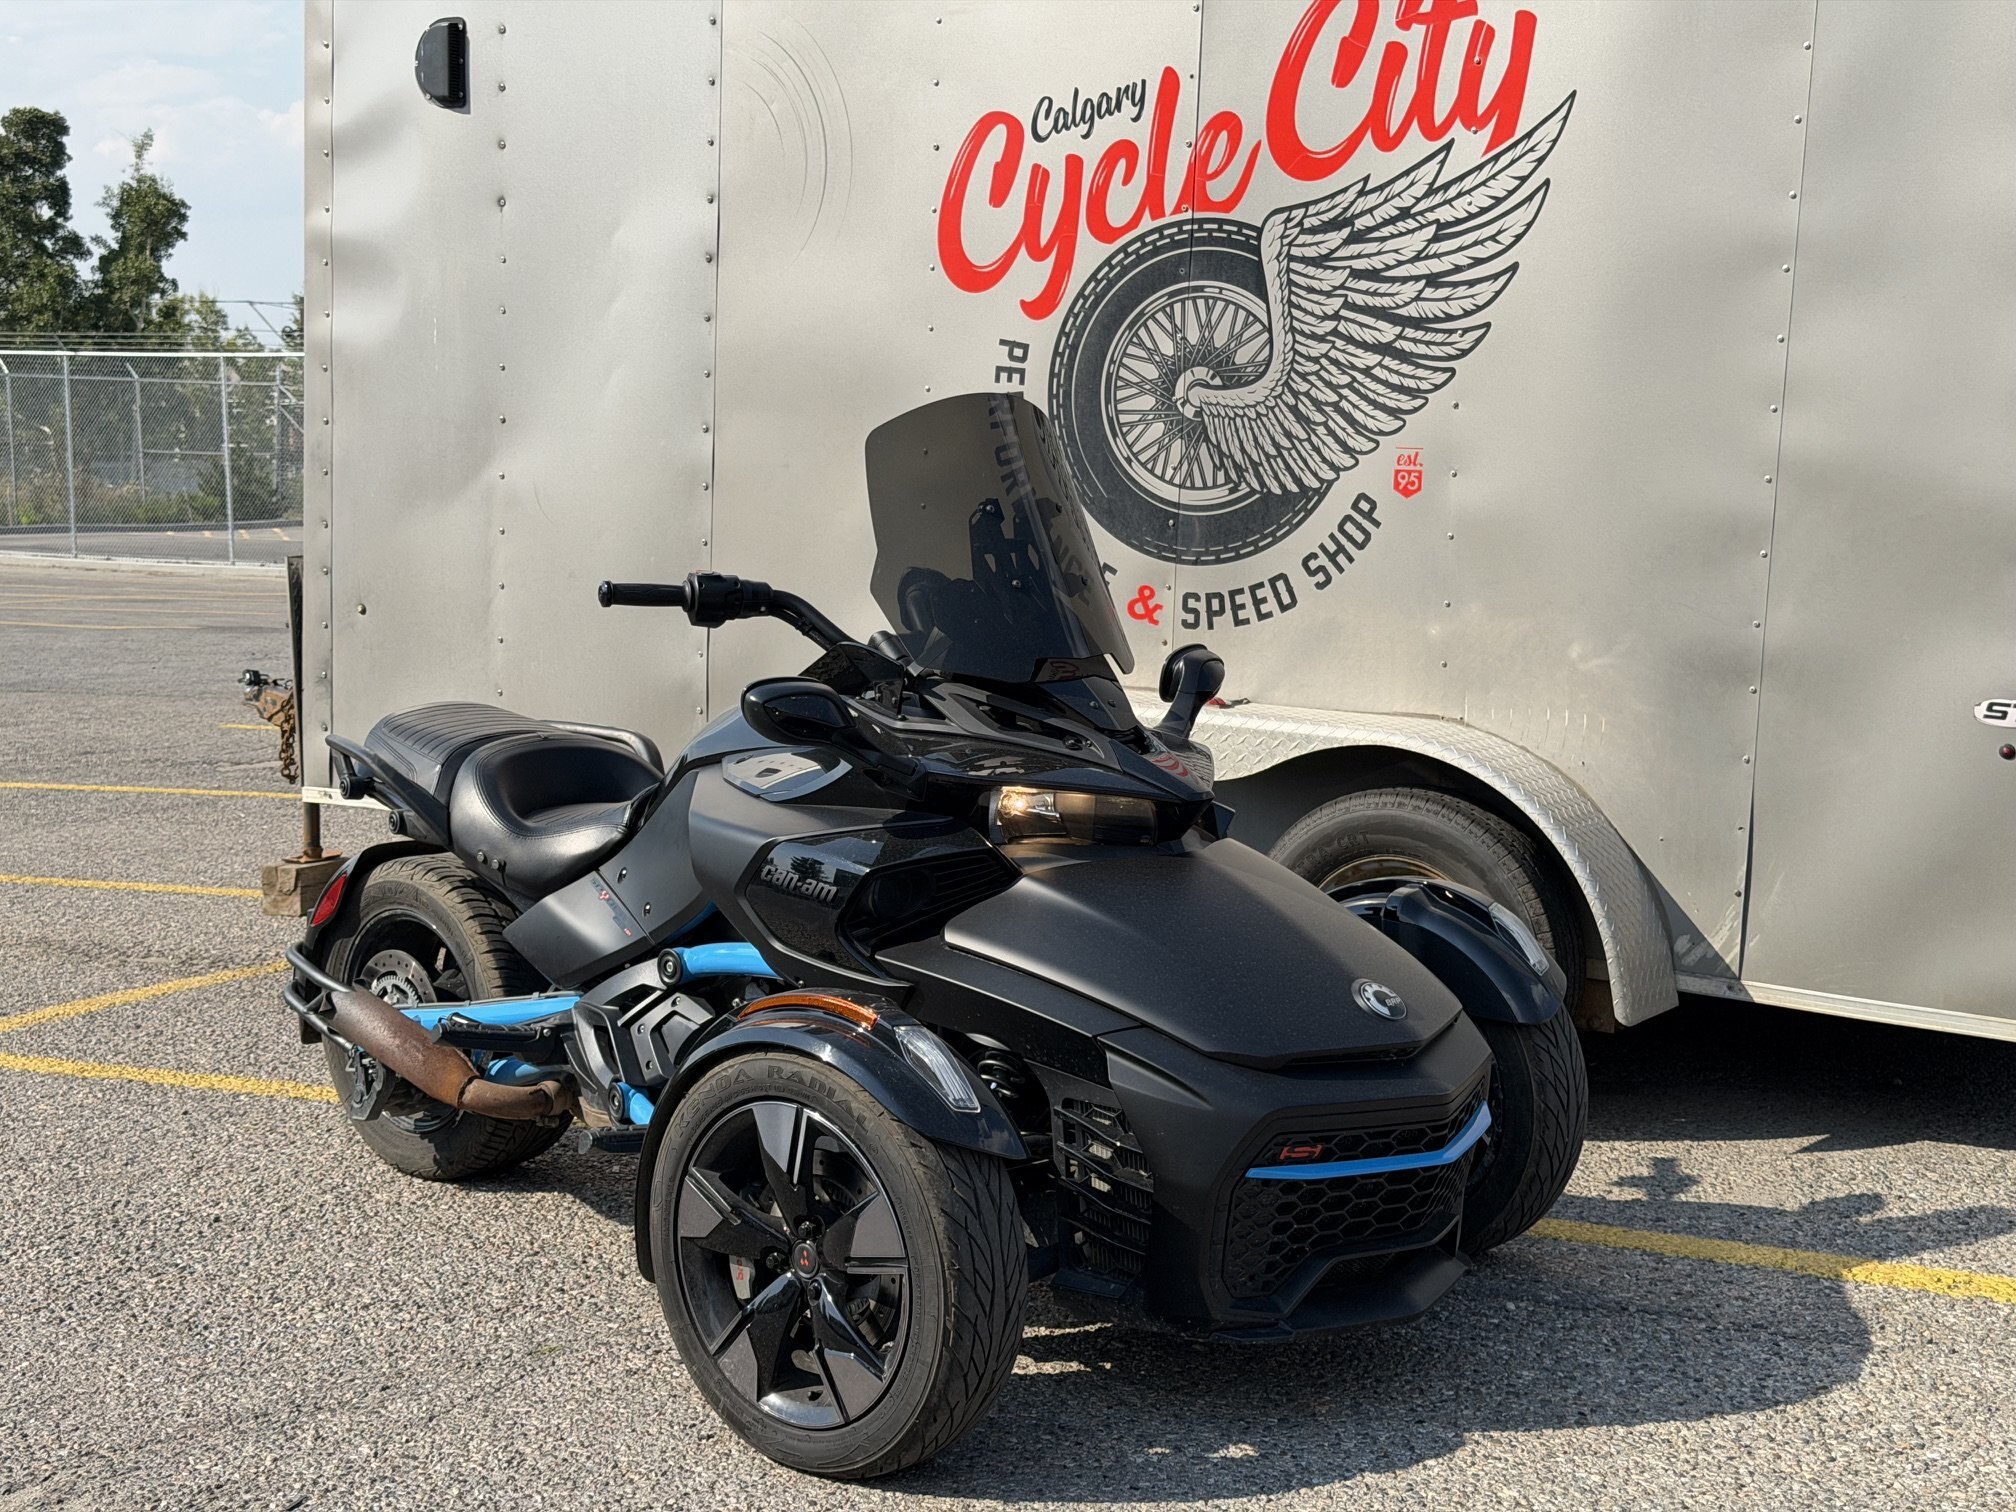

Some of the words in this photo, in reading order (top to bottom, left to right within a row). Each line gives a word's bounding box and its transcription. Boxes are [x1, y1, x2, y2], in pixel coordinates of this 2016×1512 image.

[1031, 78, 1147, 142] Calgary
[937, 66, 1262, 321] Cycle
[1266, 0, 1537, 182] City
[1396, 451, 1424, 467] est.
[1397, 472, 1419, 490] 95
[1127, 585, 1163, 625] &
[1181, 572, 1298, 631] SPEED
[1301, 492, 1383, 591] SHOP
[1983, 702, 2016, 722] S
[760, 865, 837, 902] can-am
[674, 1067, 754, 1138] KENDA
[766, 1065, 869, 1135] RADIAL
